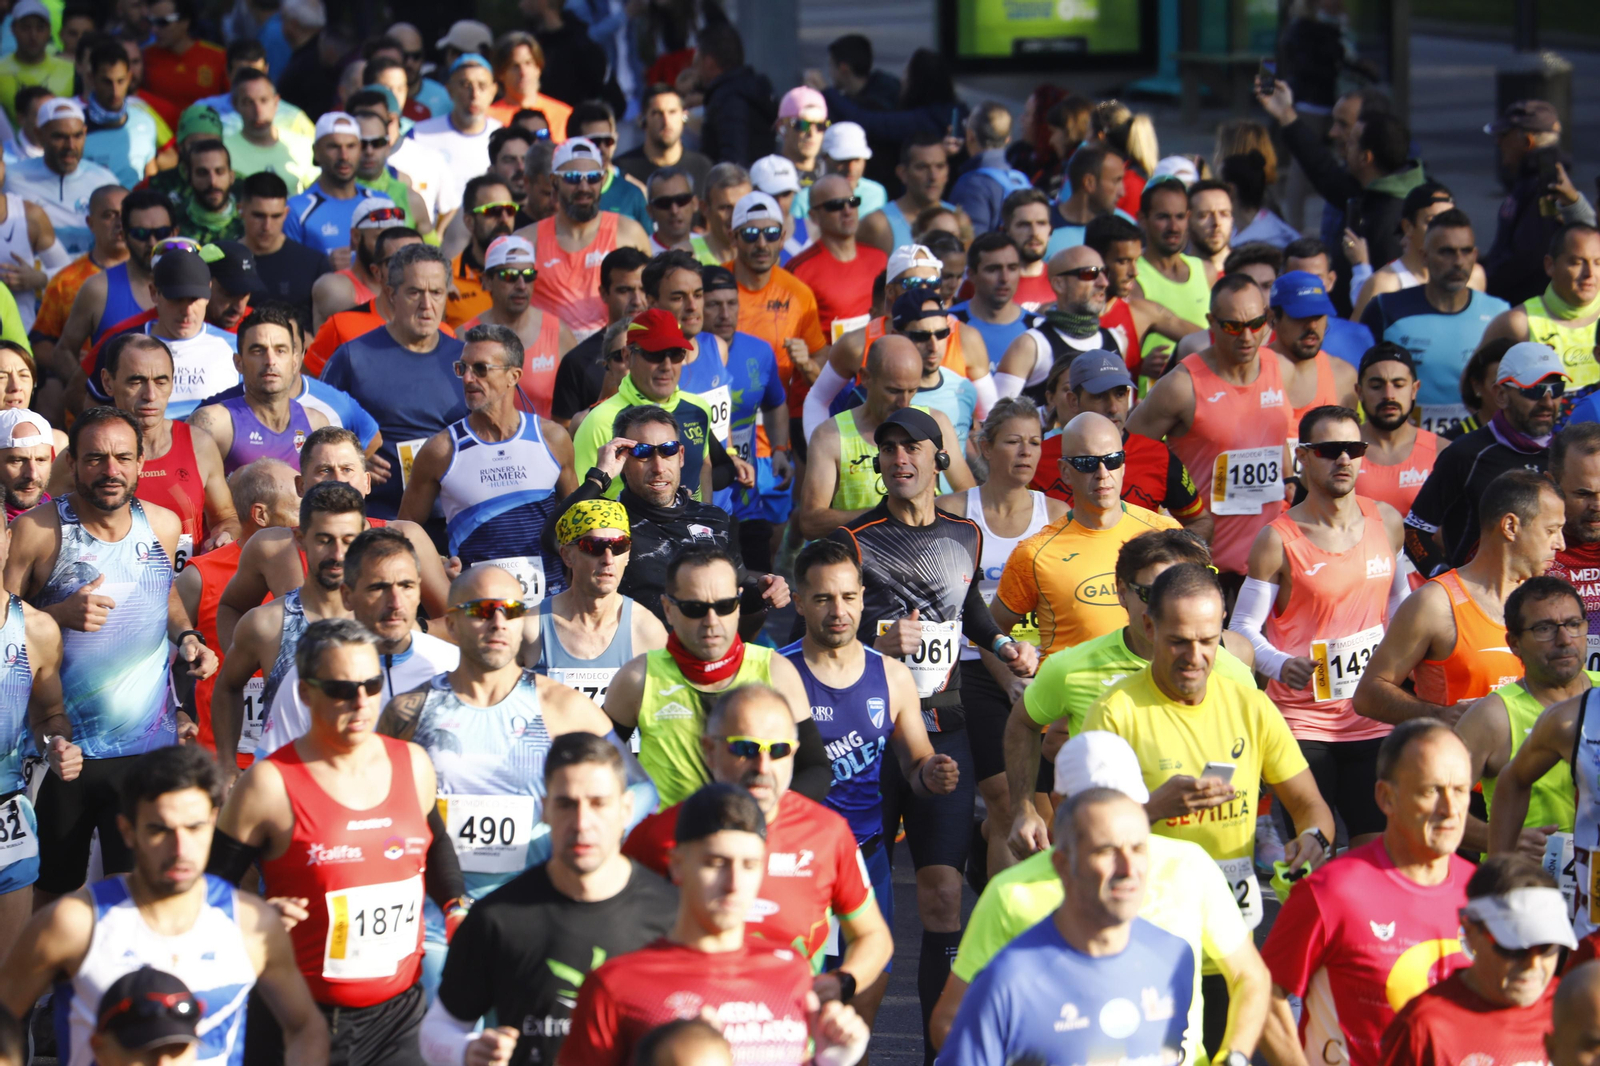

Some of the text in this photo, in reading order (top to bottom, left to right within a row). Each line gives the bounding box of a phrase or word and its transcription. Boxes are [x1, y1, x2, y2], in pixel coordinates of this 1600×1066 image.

[480, 466, 516, 476] RUNNERS
[480, 471, 528, 484] PALMERA
[1229, 461, 1278, 486] 1803
[920, 624, 936, 632] ECO
[901, 638, 953, 665] 061
[459, 815, 516, 846] 490
